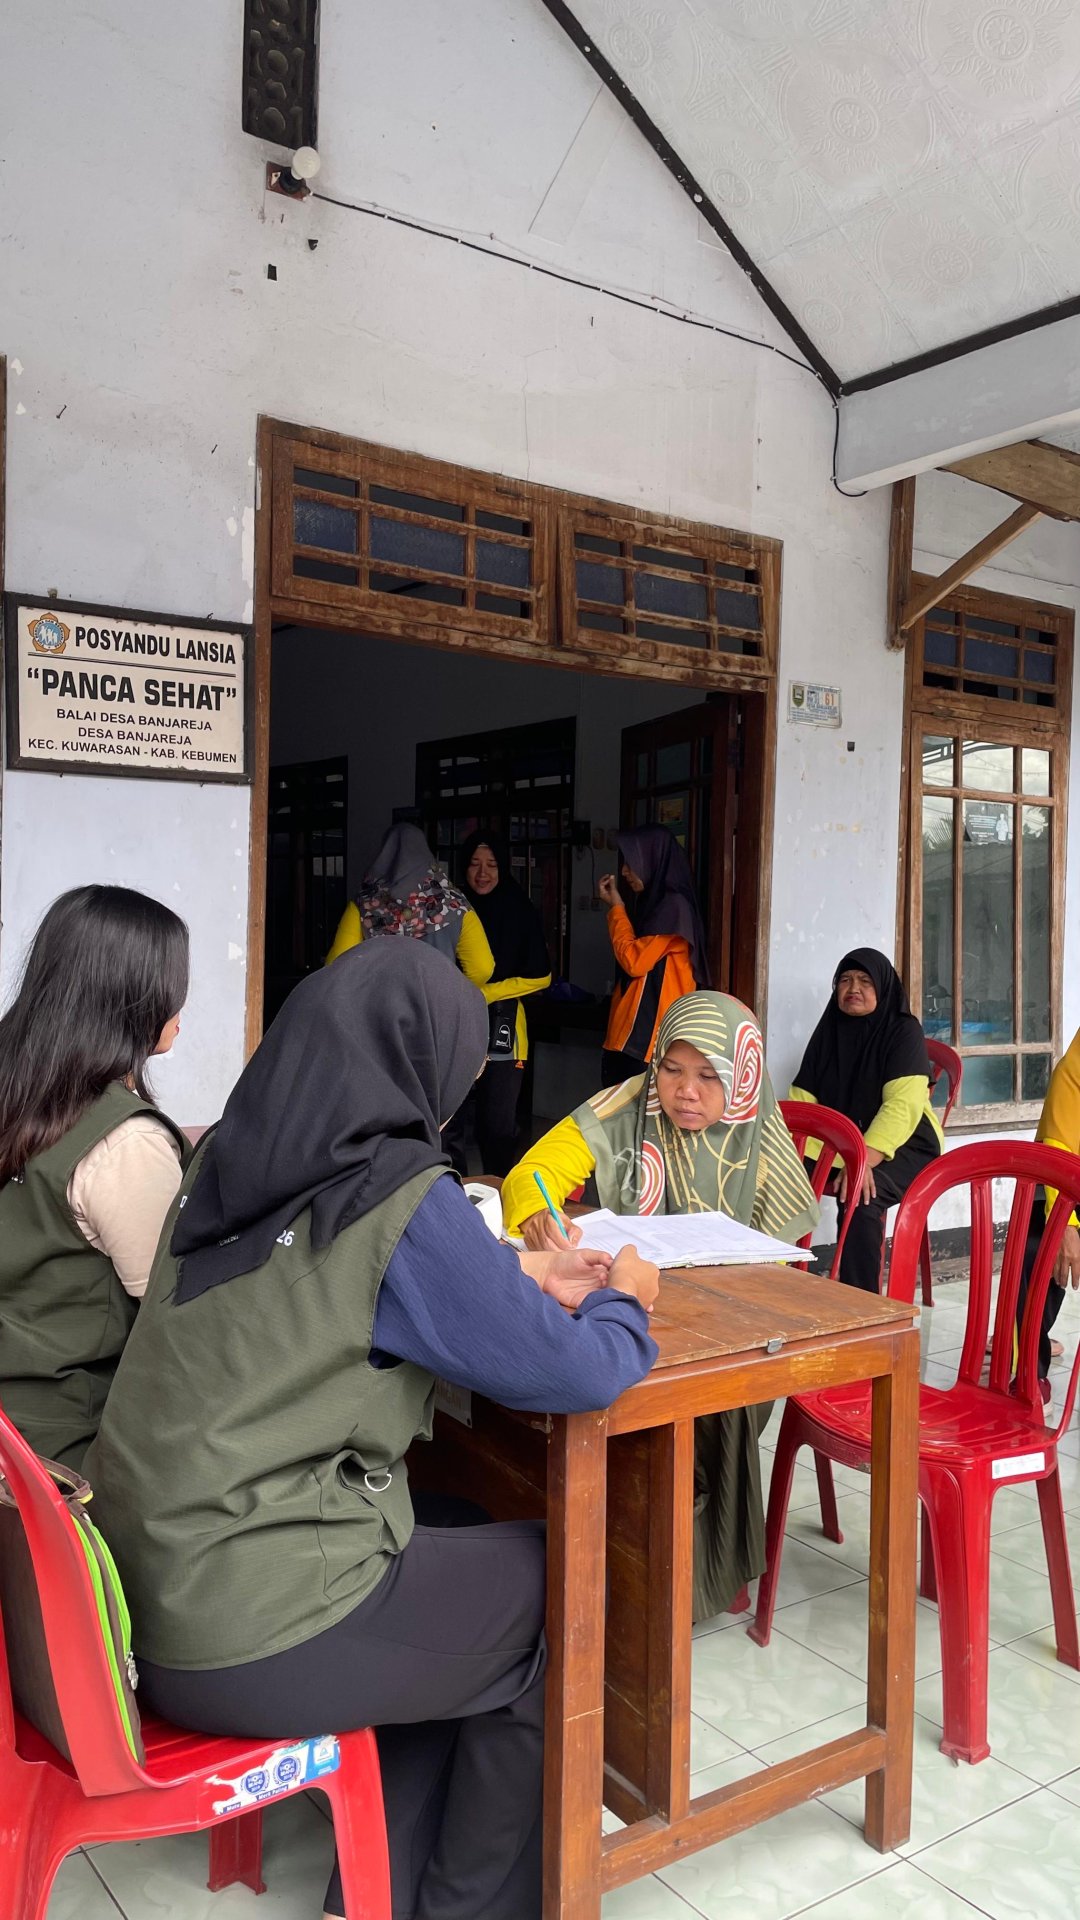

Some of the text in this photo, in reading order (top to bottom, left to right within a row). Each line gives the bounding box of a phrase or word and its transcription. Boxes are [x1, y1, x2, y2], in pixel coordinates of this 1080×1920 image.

[75, 626, 170, 657] POSYANDU
[176, 639, 236, 664] LANSIA
[825, 692, 834, 706] 61
[56, 708, 212, 731] BALAI DESA BANJAREJA
[78, 727, 192, 746] DESA BANJAREJA
[28, 738, 58, 750] KEC.
[61, 741, 140, 756] KUWARASAN
[151, 748, 178, 759] KAB.
[181, 750, 237, 763] KEBUMEN
